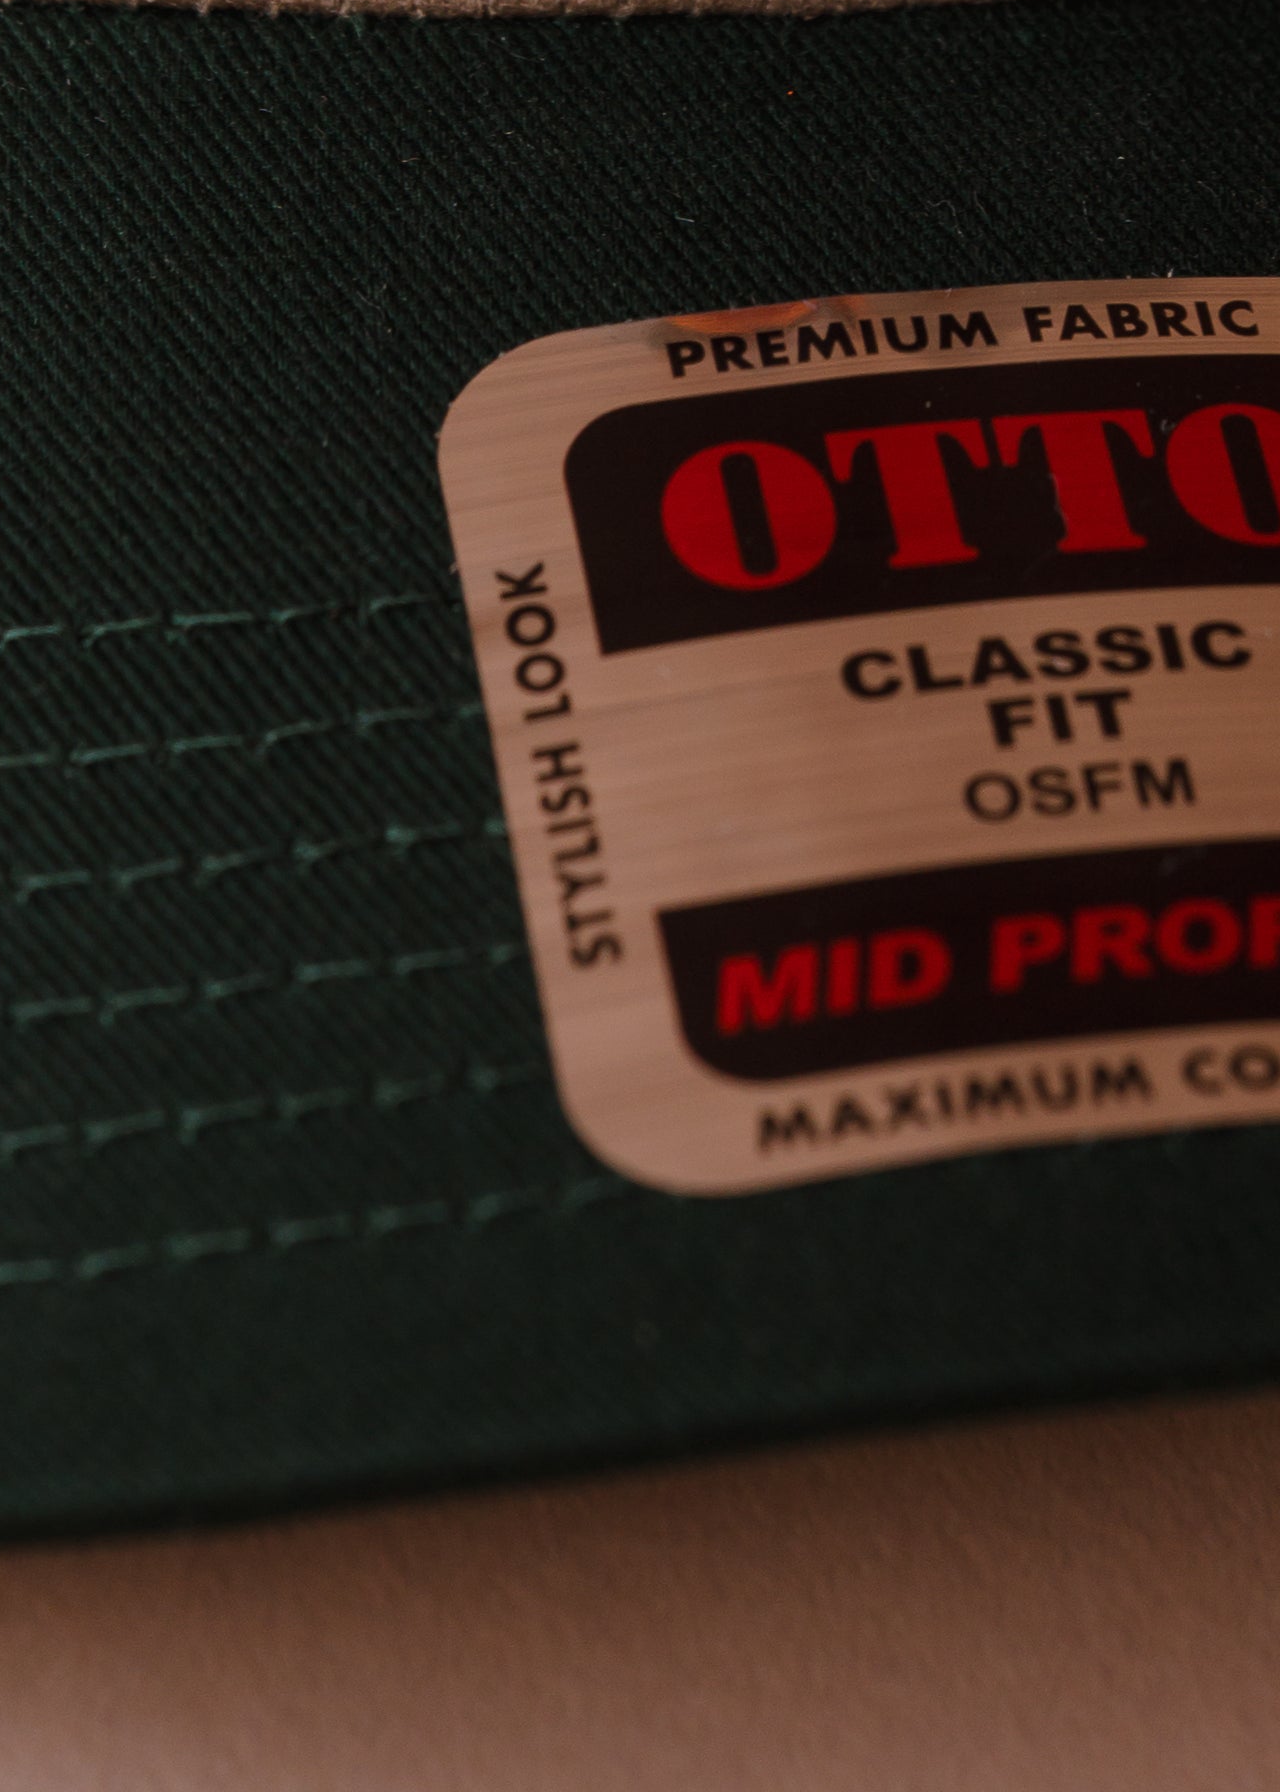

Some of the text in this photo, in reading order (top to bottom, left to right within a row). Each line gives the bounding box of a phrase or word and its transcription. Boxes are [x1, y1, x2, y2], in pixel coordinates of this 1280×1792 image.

[666, 299, 1260, 379] PREMIUM FABRIC
[840, 620, 1254, 702] CLASSIC
[987, 690, 1132, 750] FIT
[496, 563, 623, 970] STYLISH LOOK
[963, 757, 1196, 825] OSFM
[720, 929, 949, 1036] MID
[756, 1051, 1155, 1156] MAXIMUM
